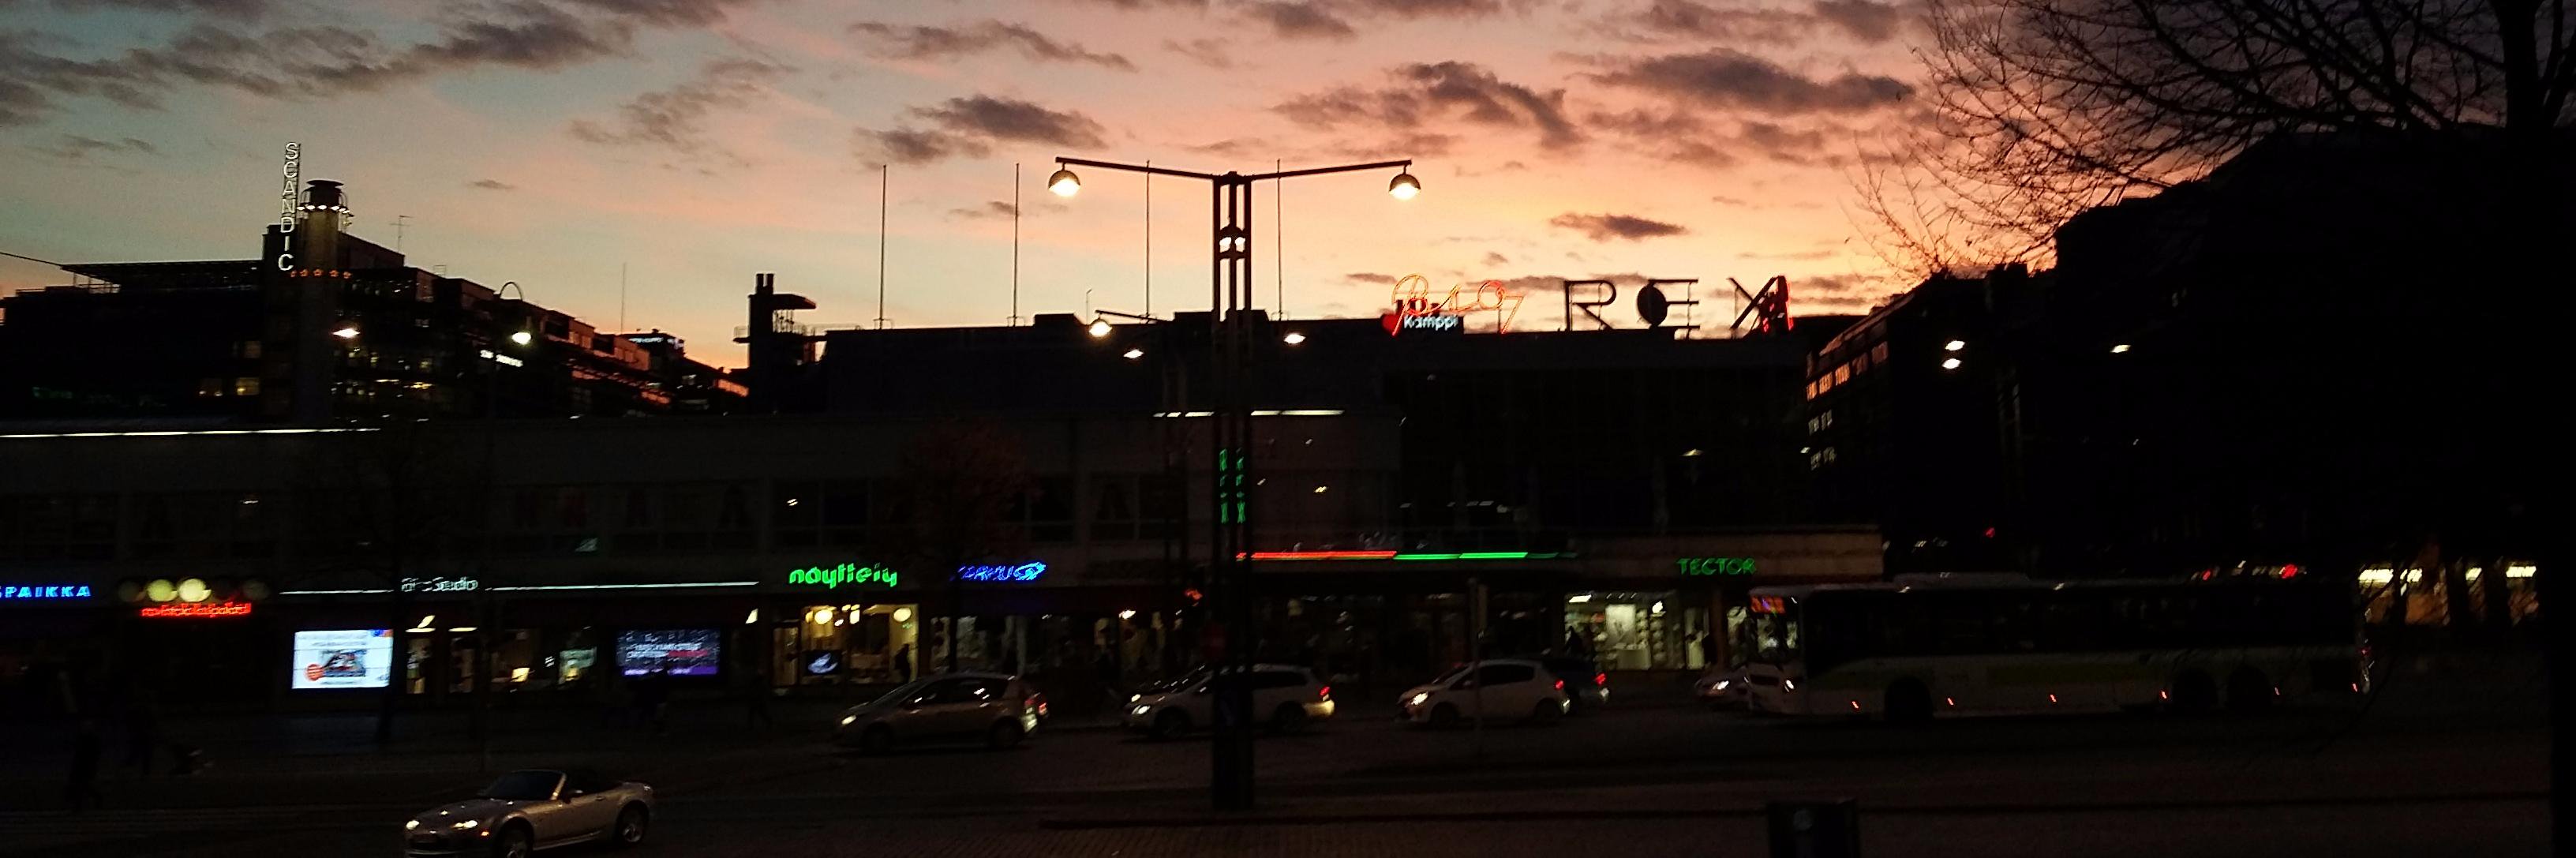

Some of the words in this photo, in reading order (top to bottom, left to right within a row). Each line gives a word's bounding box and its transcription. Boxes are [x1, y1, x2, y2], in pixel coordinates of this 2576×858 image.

[278, 142, 299, 271] SCANDIC
[1564, 275, 1773, 331] REX
[1677, 558, 1756, 575] TECTOR
